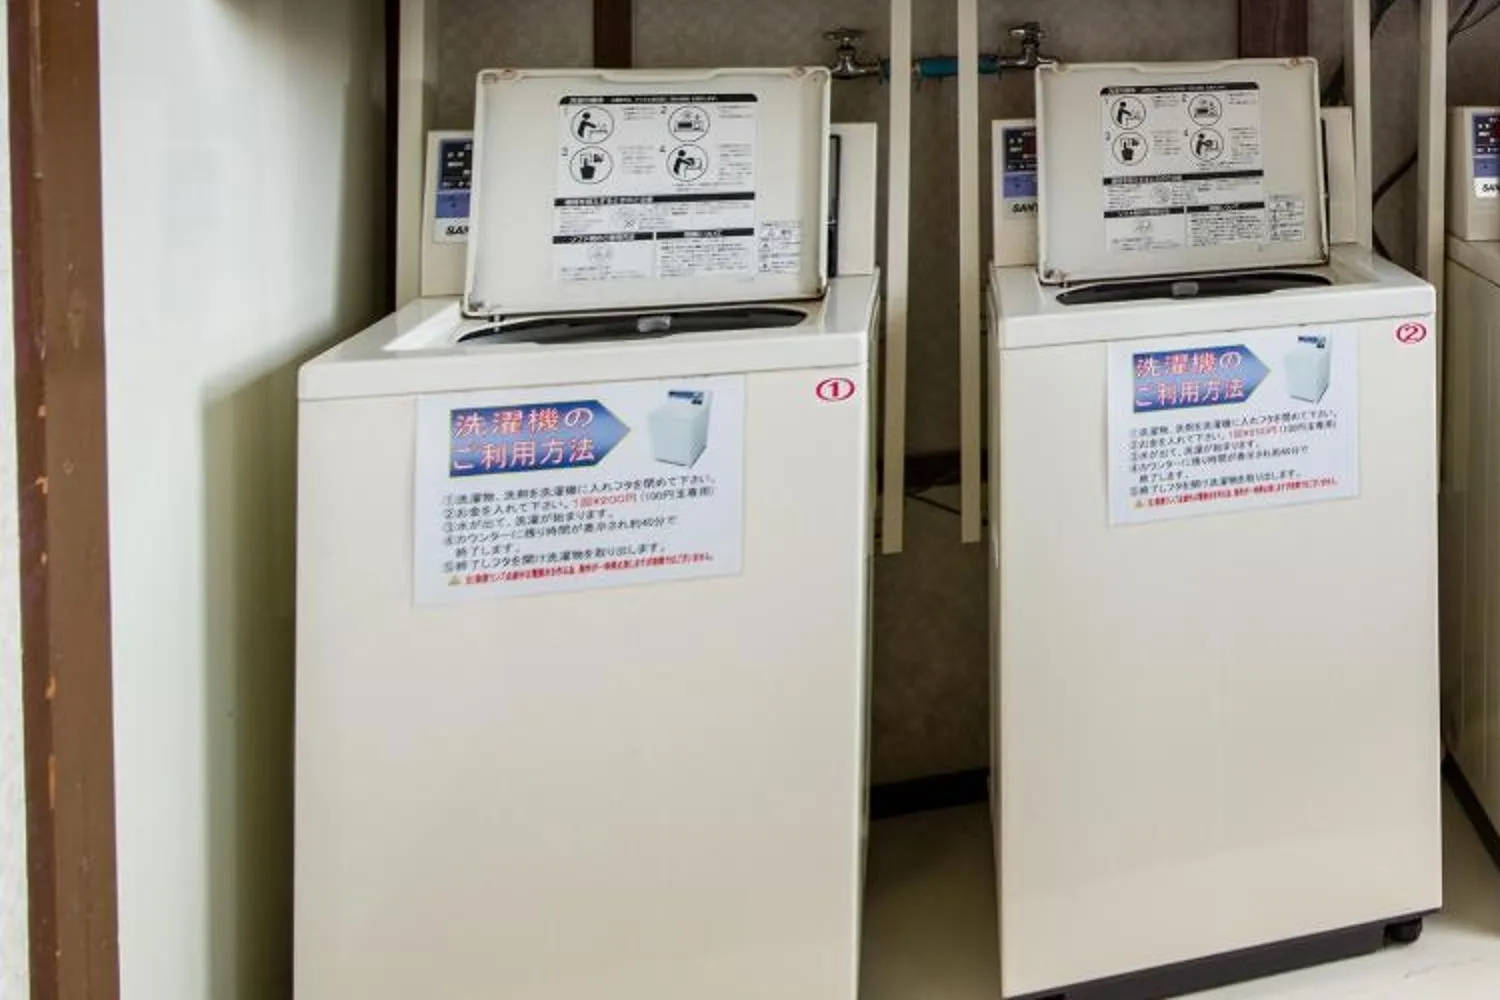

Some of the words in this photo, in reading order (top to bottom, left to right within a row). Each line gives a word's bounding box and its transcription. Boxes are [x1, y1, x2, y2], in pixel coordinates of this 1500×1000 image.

[1136, 351, 1242, 378] 洗濯機の
[1135, 378, 1245, 406] ご利用方法
[454, 407, 594, 438] 洗濯機の
[453, 439, 596, 471] ご利用方法
